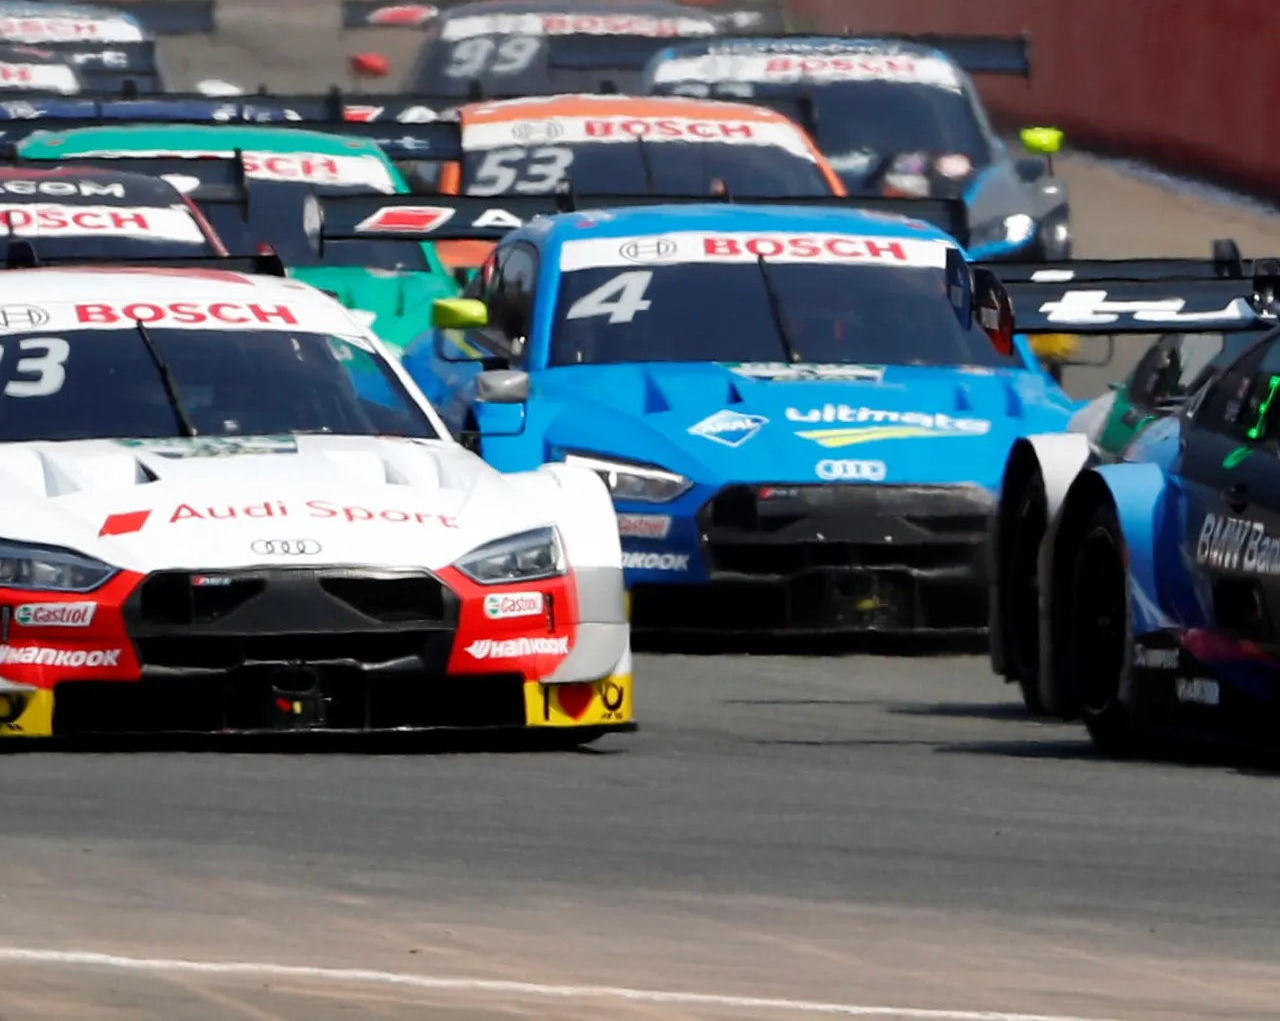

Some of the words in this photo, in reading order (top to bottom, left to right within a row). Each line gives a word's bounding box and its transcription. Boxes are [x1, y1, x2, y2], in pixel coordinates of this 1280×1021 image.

[543, 15, 678, 36] BOSCH
[444, 36, 543, 78] 99
[765, 57, 917, 75] BOSCH
[584, 120, 754, 139] BOSCH
[464, 146, 574, 197] 53
[703, 237, 907, 261] BOSCH
[566, 271, 653, 324] 4
[76, 303, 301, 325] BOSCH
[785, 404, 991, 433] ultimate
[169, 501, 288, 523] Audi
[307, 501, 460, 529] Sport
[1197, 513, 1249, 570] BMW
[33, 604, 89, 625] Castrol
